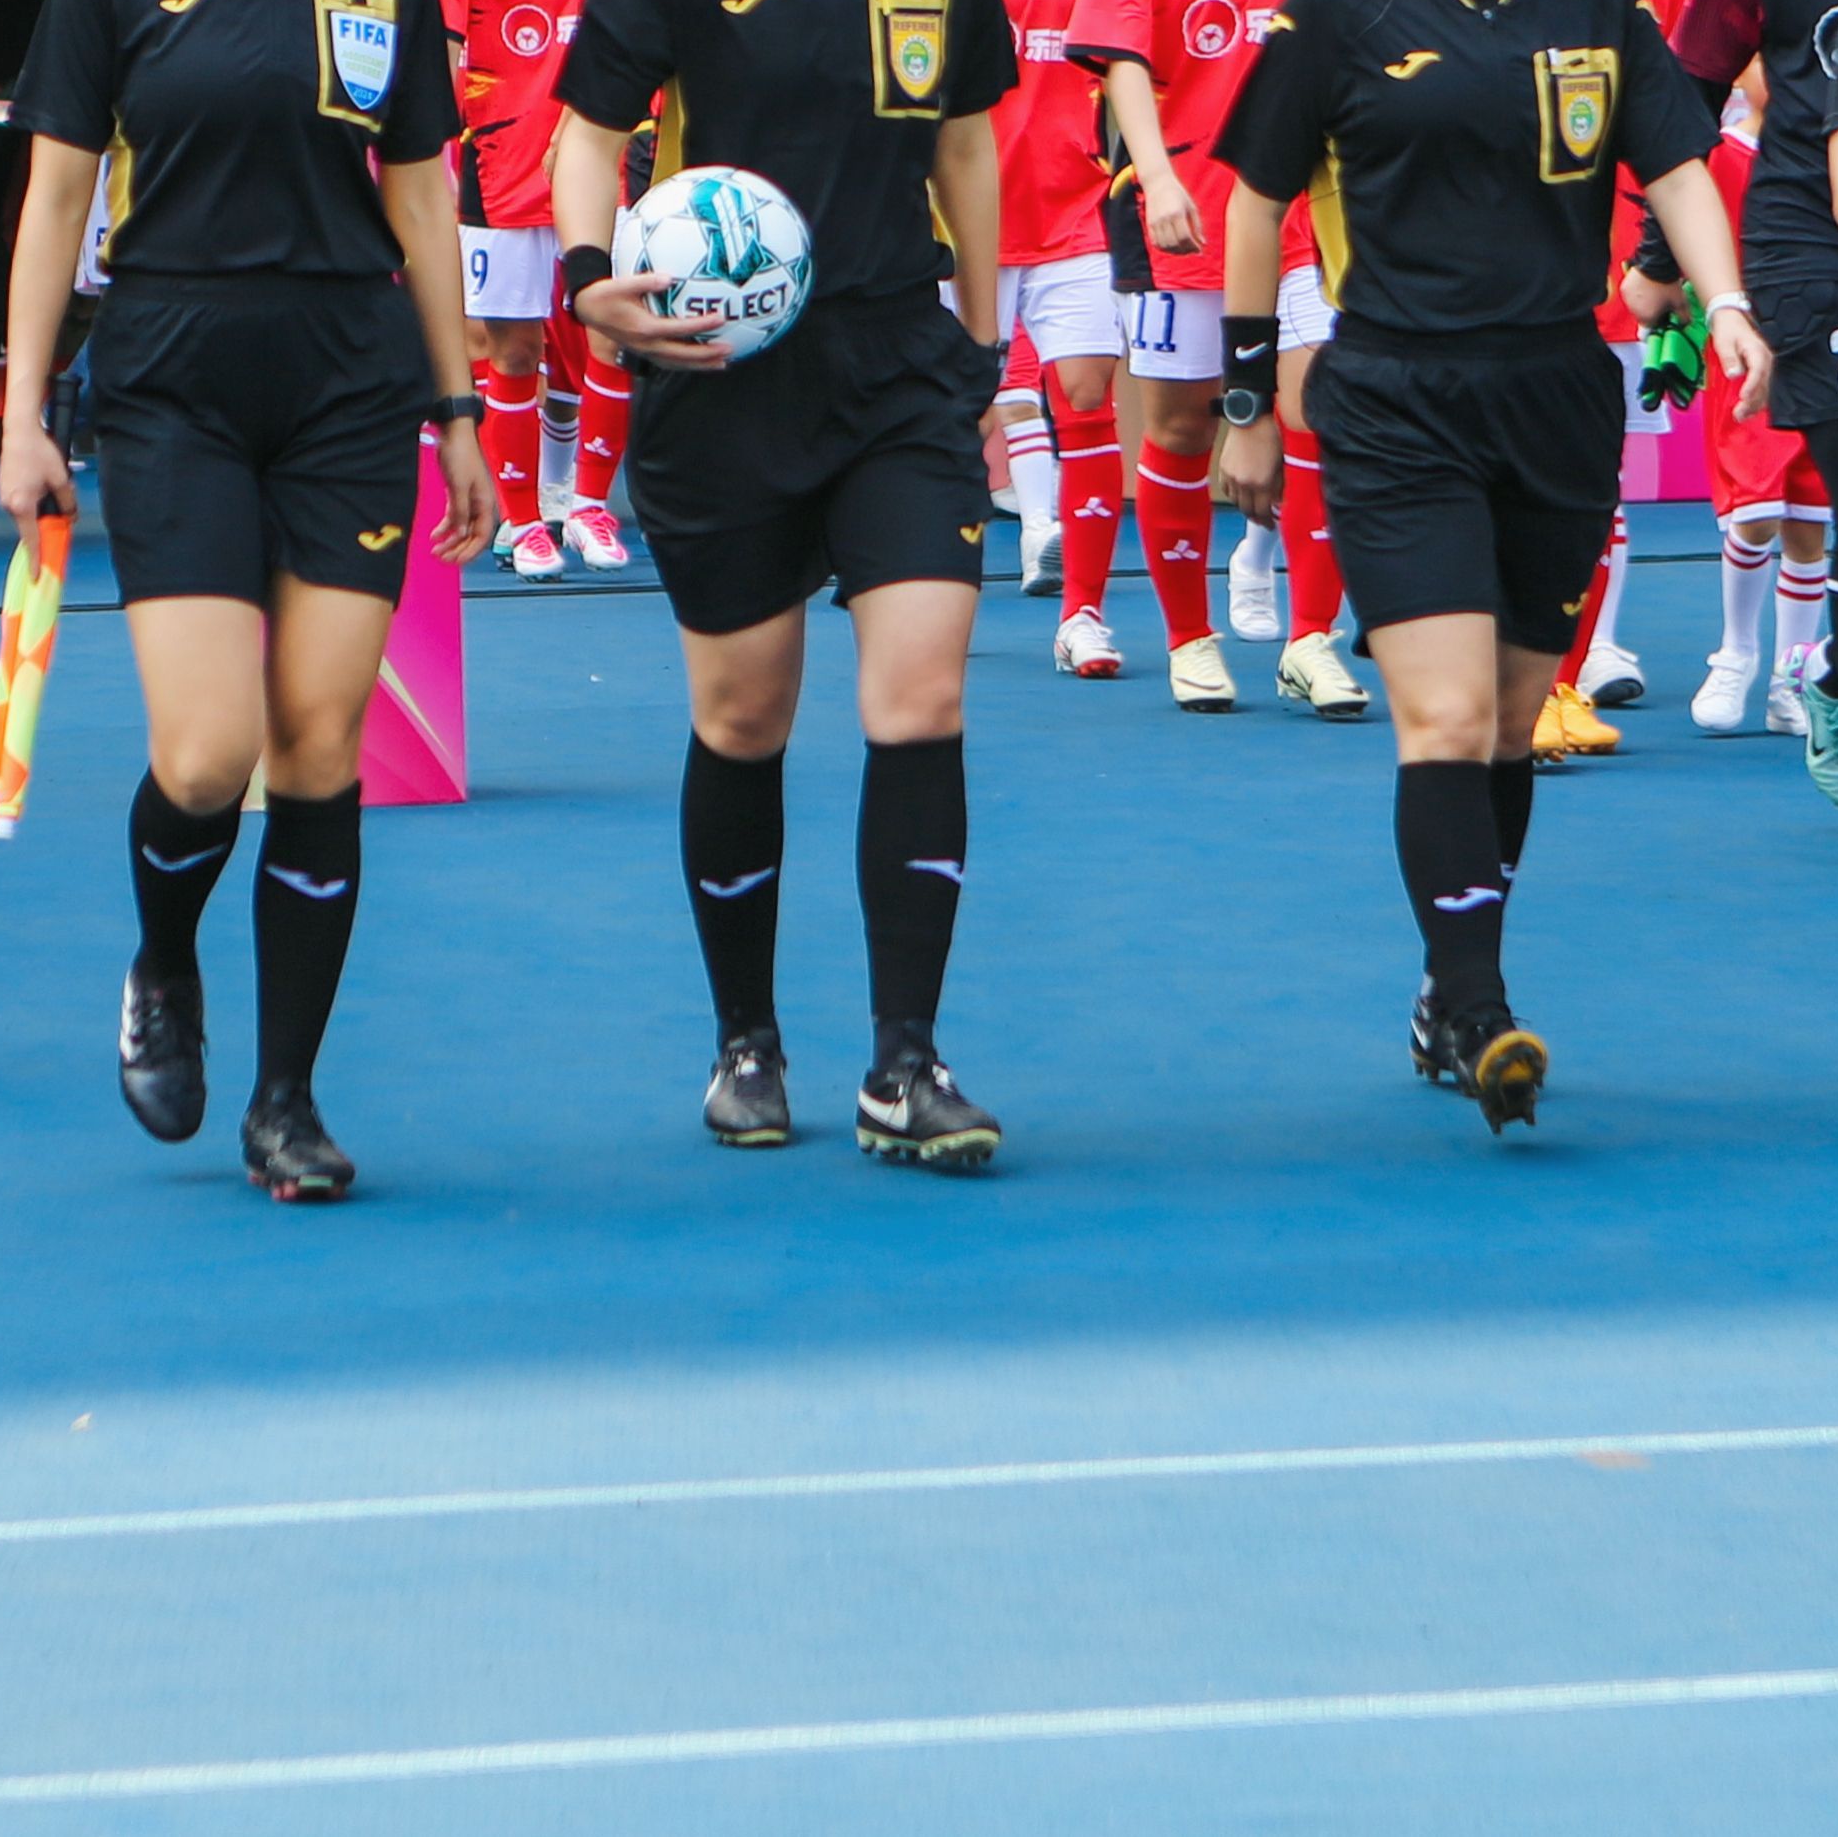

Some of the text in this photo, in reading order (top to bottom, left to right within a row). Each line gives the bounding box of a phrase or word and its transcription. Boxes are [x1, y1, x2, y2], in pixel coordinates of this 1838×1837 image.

[338, 19, 387, 50] FIFA
[468, 247, 491, 295] 9
[684, 282, 788, 322] SELECT
[1130, 292, 1177, 353] 11
